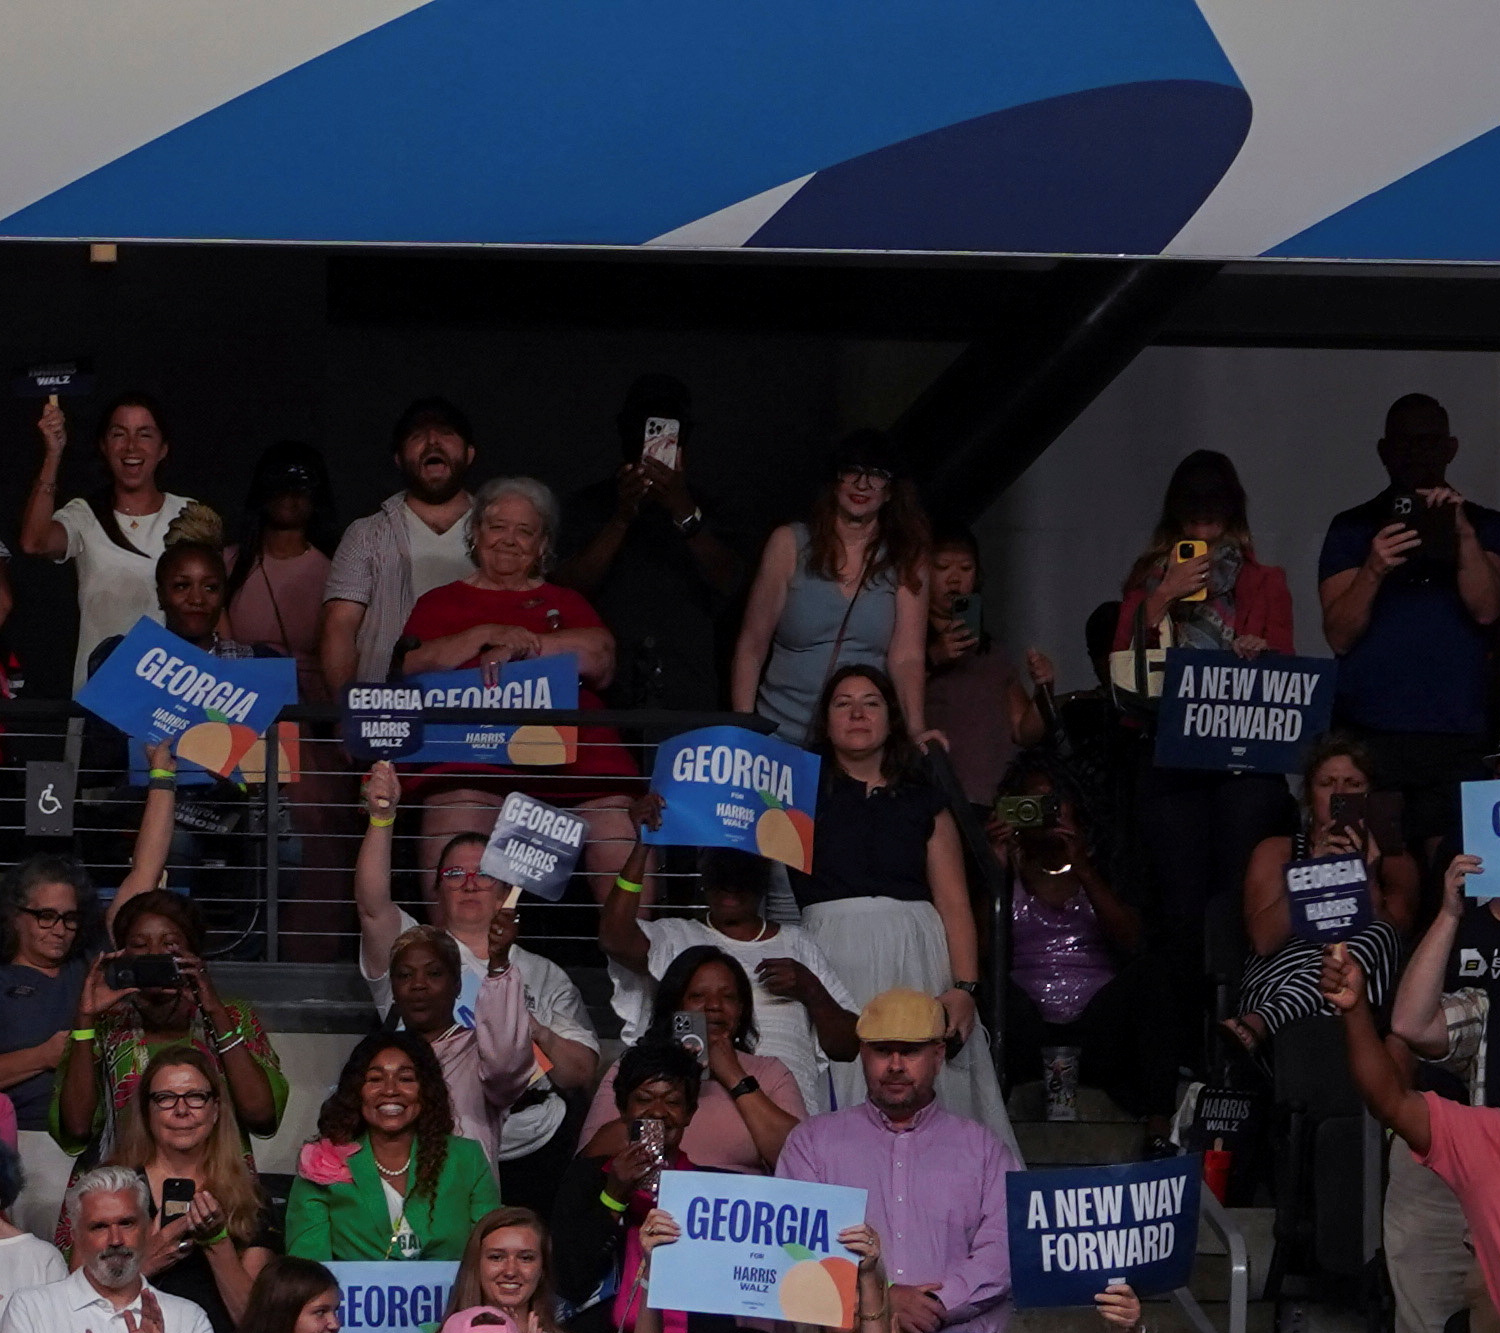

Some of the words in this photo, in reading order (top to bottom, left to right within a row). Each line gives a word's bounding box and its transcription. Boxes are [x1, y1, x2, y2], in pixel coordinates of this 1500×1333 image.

[135, 648, 259, 720] GEORGIA
[348, 688, 422, 710] GEORGIA
[1180, 664, 1196, 700] A
[1201, 665, 1257, 703] NEW
[1262, 668, 1320, 706] WAY
[151, 706, 190, 733] HARRIS
[153, 719, 179, 736] WALZ
[360, 719, 411, 739] HARRIS
[1182, 702, 1303, 741] FORWARD
[672, 746, 794, 804] GEORGIA
[505, 799, 584, 846] GEORGIA
[1201, 1097, 1251, 1121] HARRIS
[1206, 1117, 1238, 1132] WALZ
[1027, 1188, 1045, 1230] A
[1051, 1182, 1120, 1228] NEW
[1127, 1174, 1185, 1221] WAY
[688, 1197, 828, 1251] GEORGIA
[1043, 1222, 1175, 1272] FORWARD
[733, 1265, 777, 1284] HARRIS
[740, 1281, 768, 1293] WALZ
